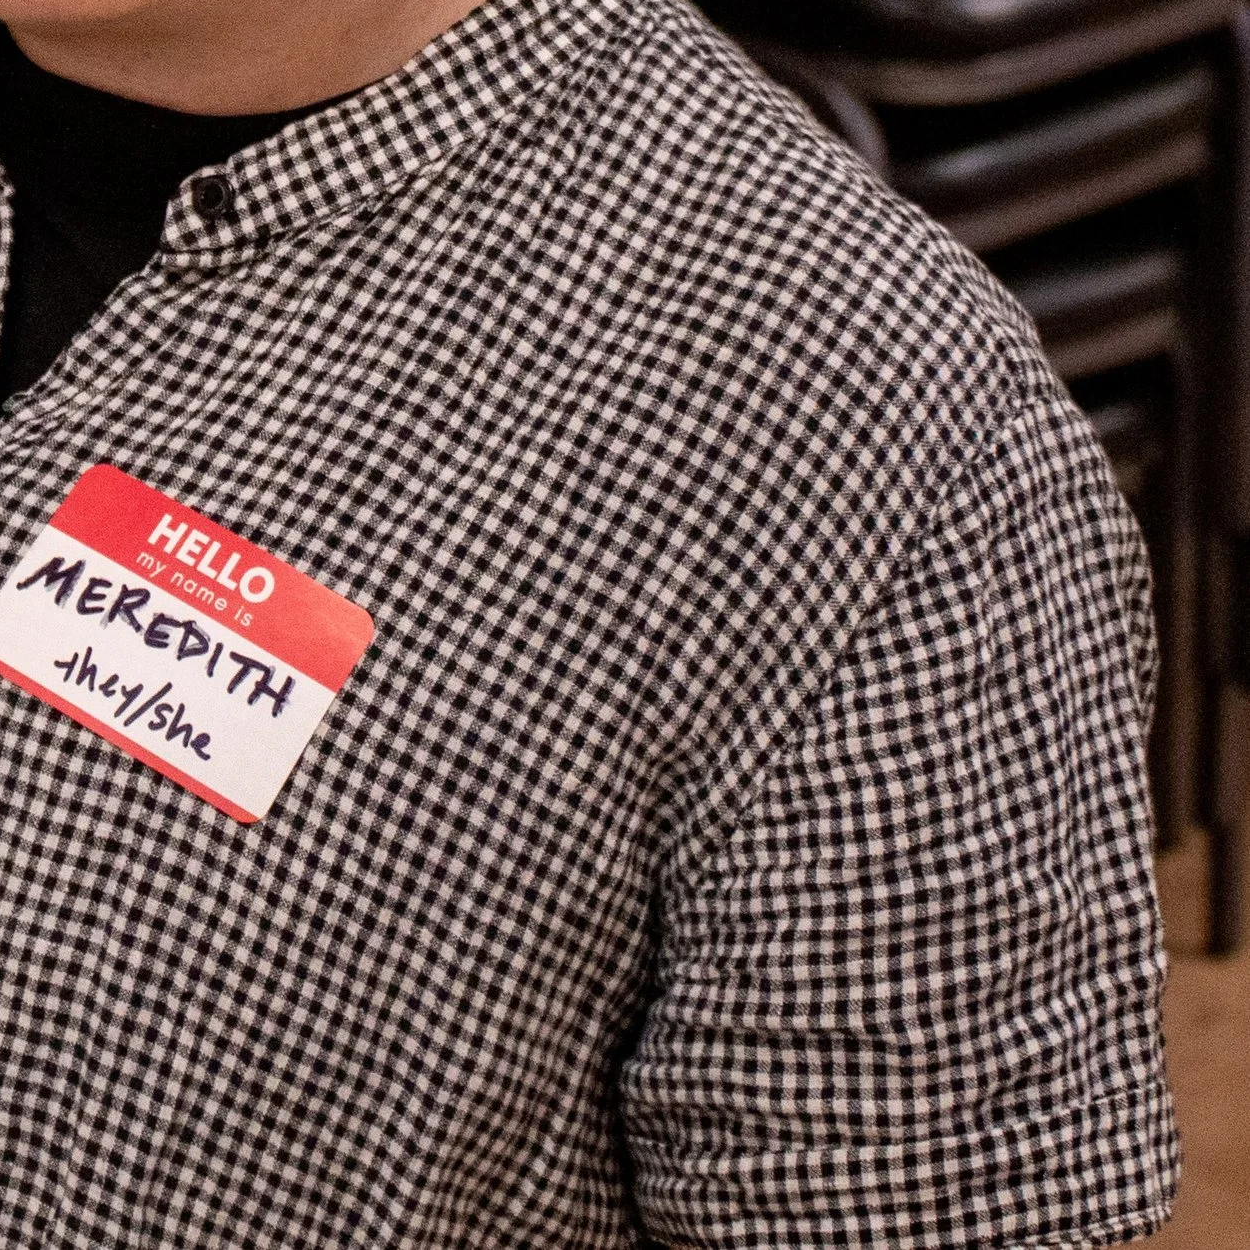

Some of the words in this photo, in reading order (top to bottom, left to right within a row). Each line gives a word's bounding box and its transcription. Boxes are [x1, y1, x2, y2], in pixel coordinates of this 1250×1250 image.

[135, 551, 167, 578] my
[170, 572, 229, 612] name
[234, 604, 254, 628] is
[147, 514, 275, 603] HELLO
[16, 556, 297, 718] MEREDITH
[53, 646, 212, 762] they/she
